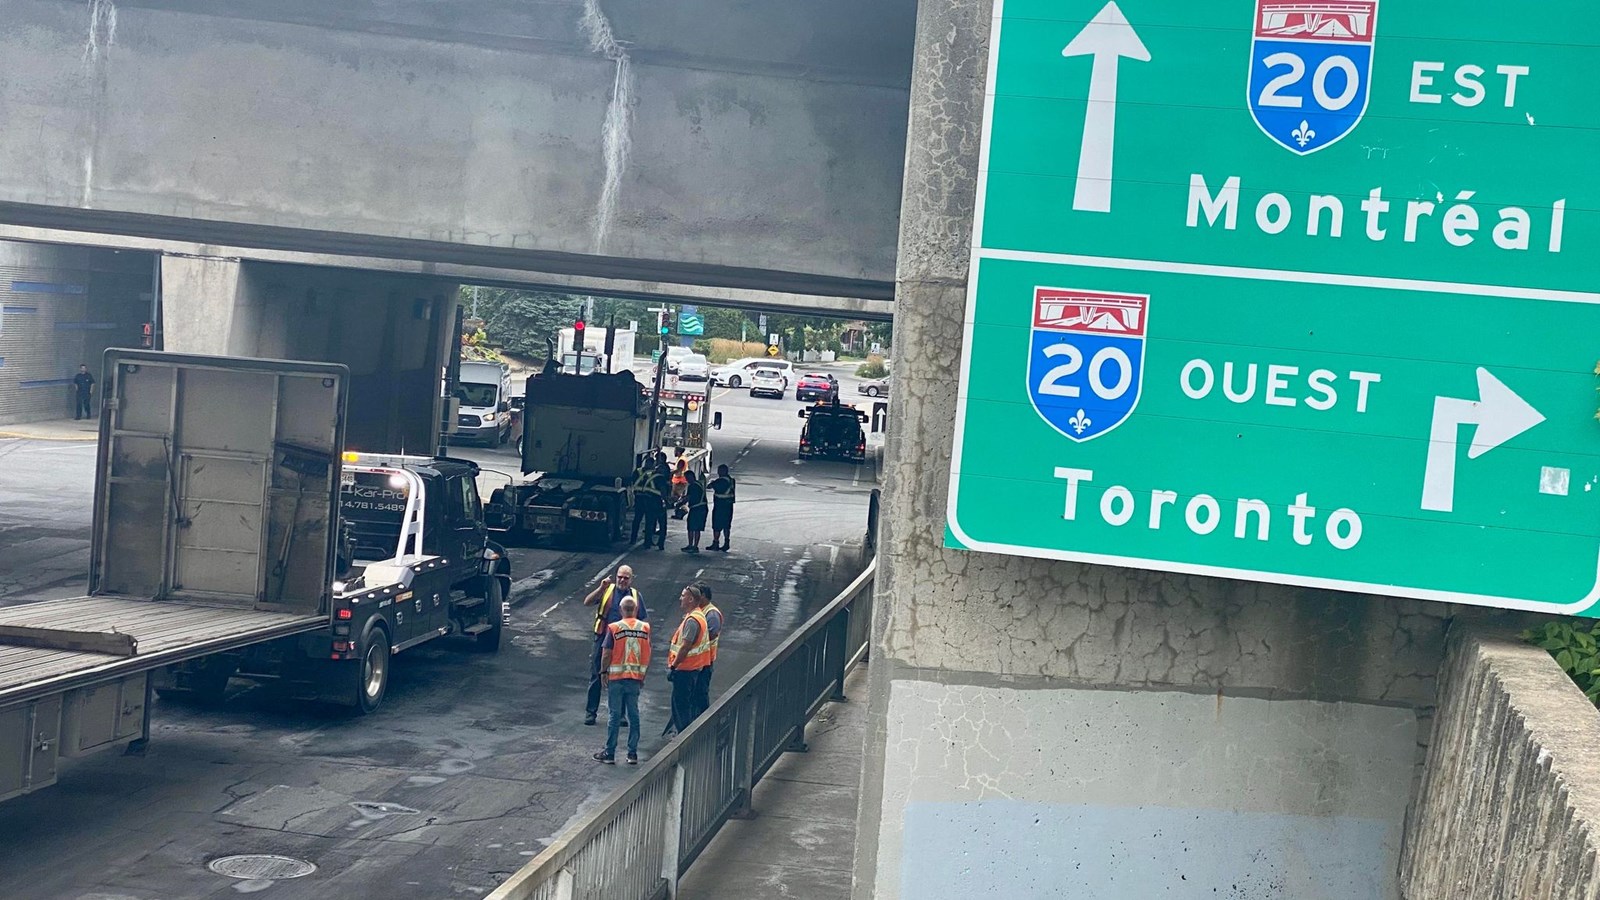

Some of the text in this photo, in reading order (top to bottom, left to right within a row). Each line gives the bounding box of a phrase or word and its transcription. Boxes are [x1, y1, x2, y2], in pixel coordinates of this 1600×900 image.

[1257, 53, 1530, 111] 20 EST
[1185, 174, 1566, 253] Montréal
[1037, 343, 1382, 413] 20 OUEST
[354, 487, 406, 500] Kar-Pro
[1053, 466, 1364, 551] Toronto
